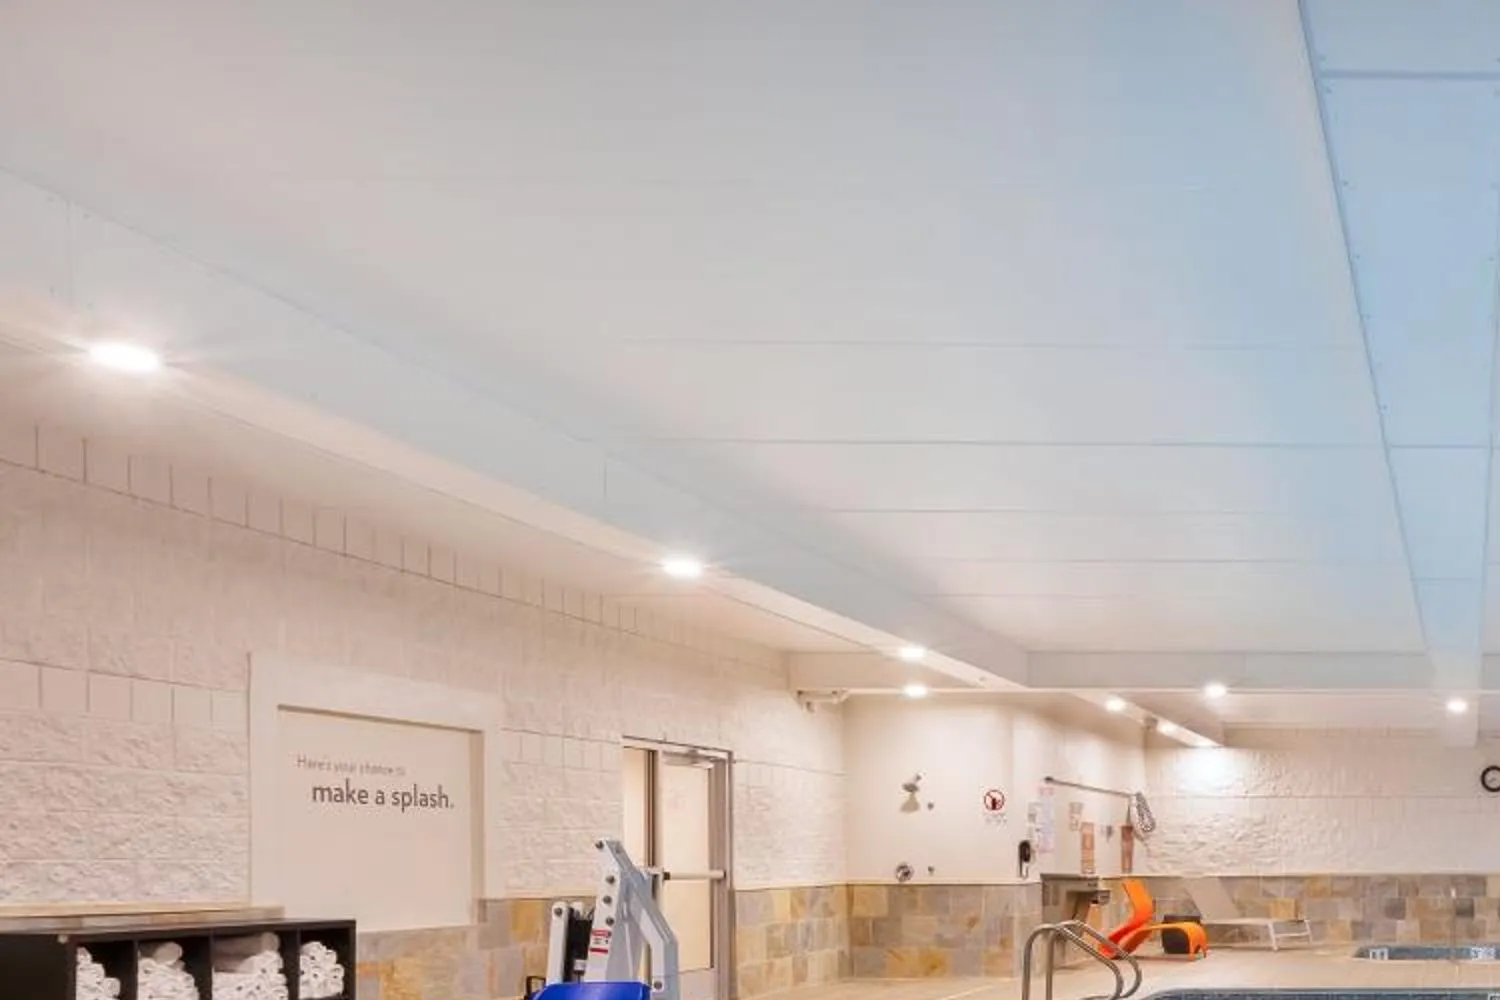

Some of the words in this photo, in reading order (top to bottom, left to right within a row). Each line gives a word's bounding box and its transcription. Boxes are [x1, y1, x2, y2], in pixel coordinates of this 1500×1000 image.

[312, 778, 369, 805] make
[375, 790, 386, 805] a
[391, 784, 455, 813] splash.
